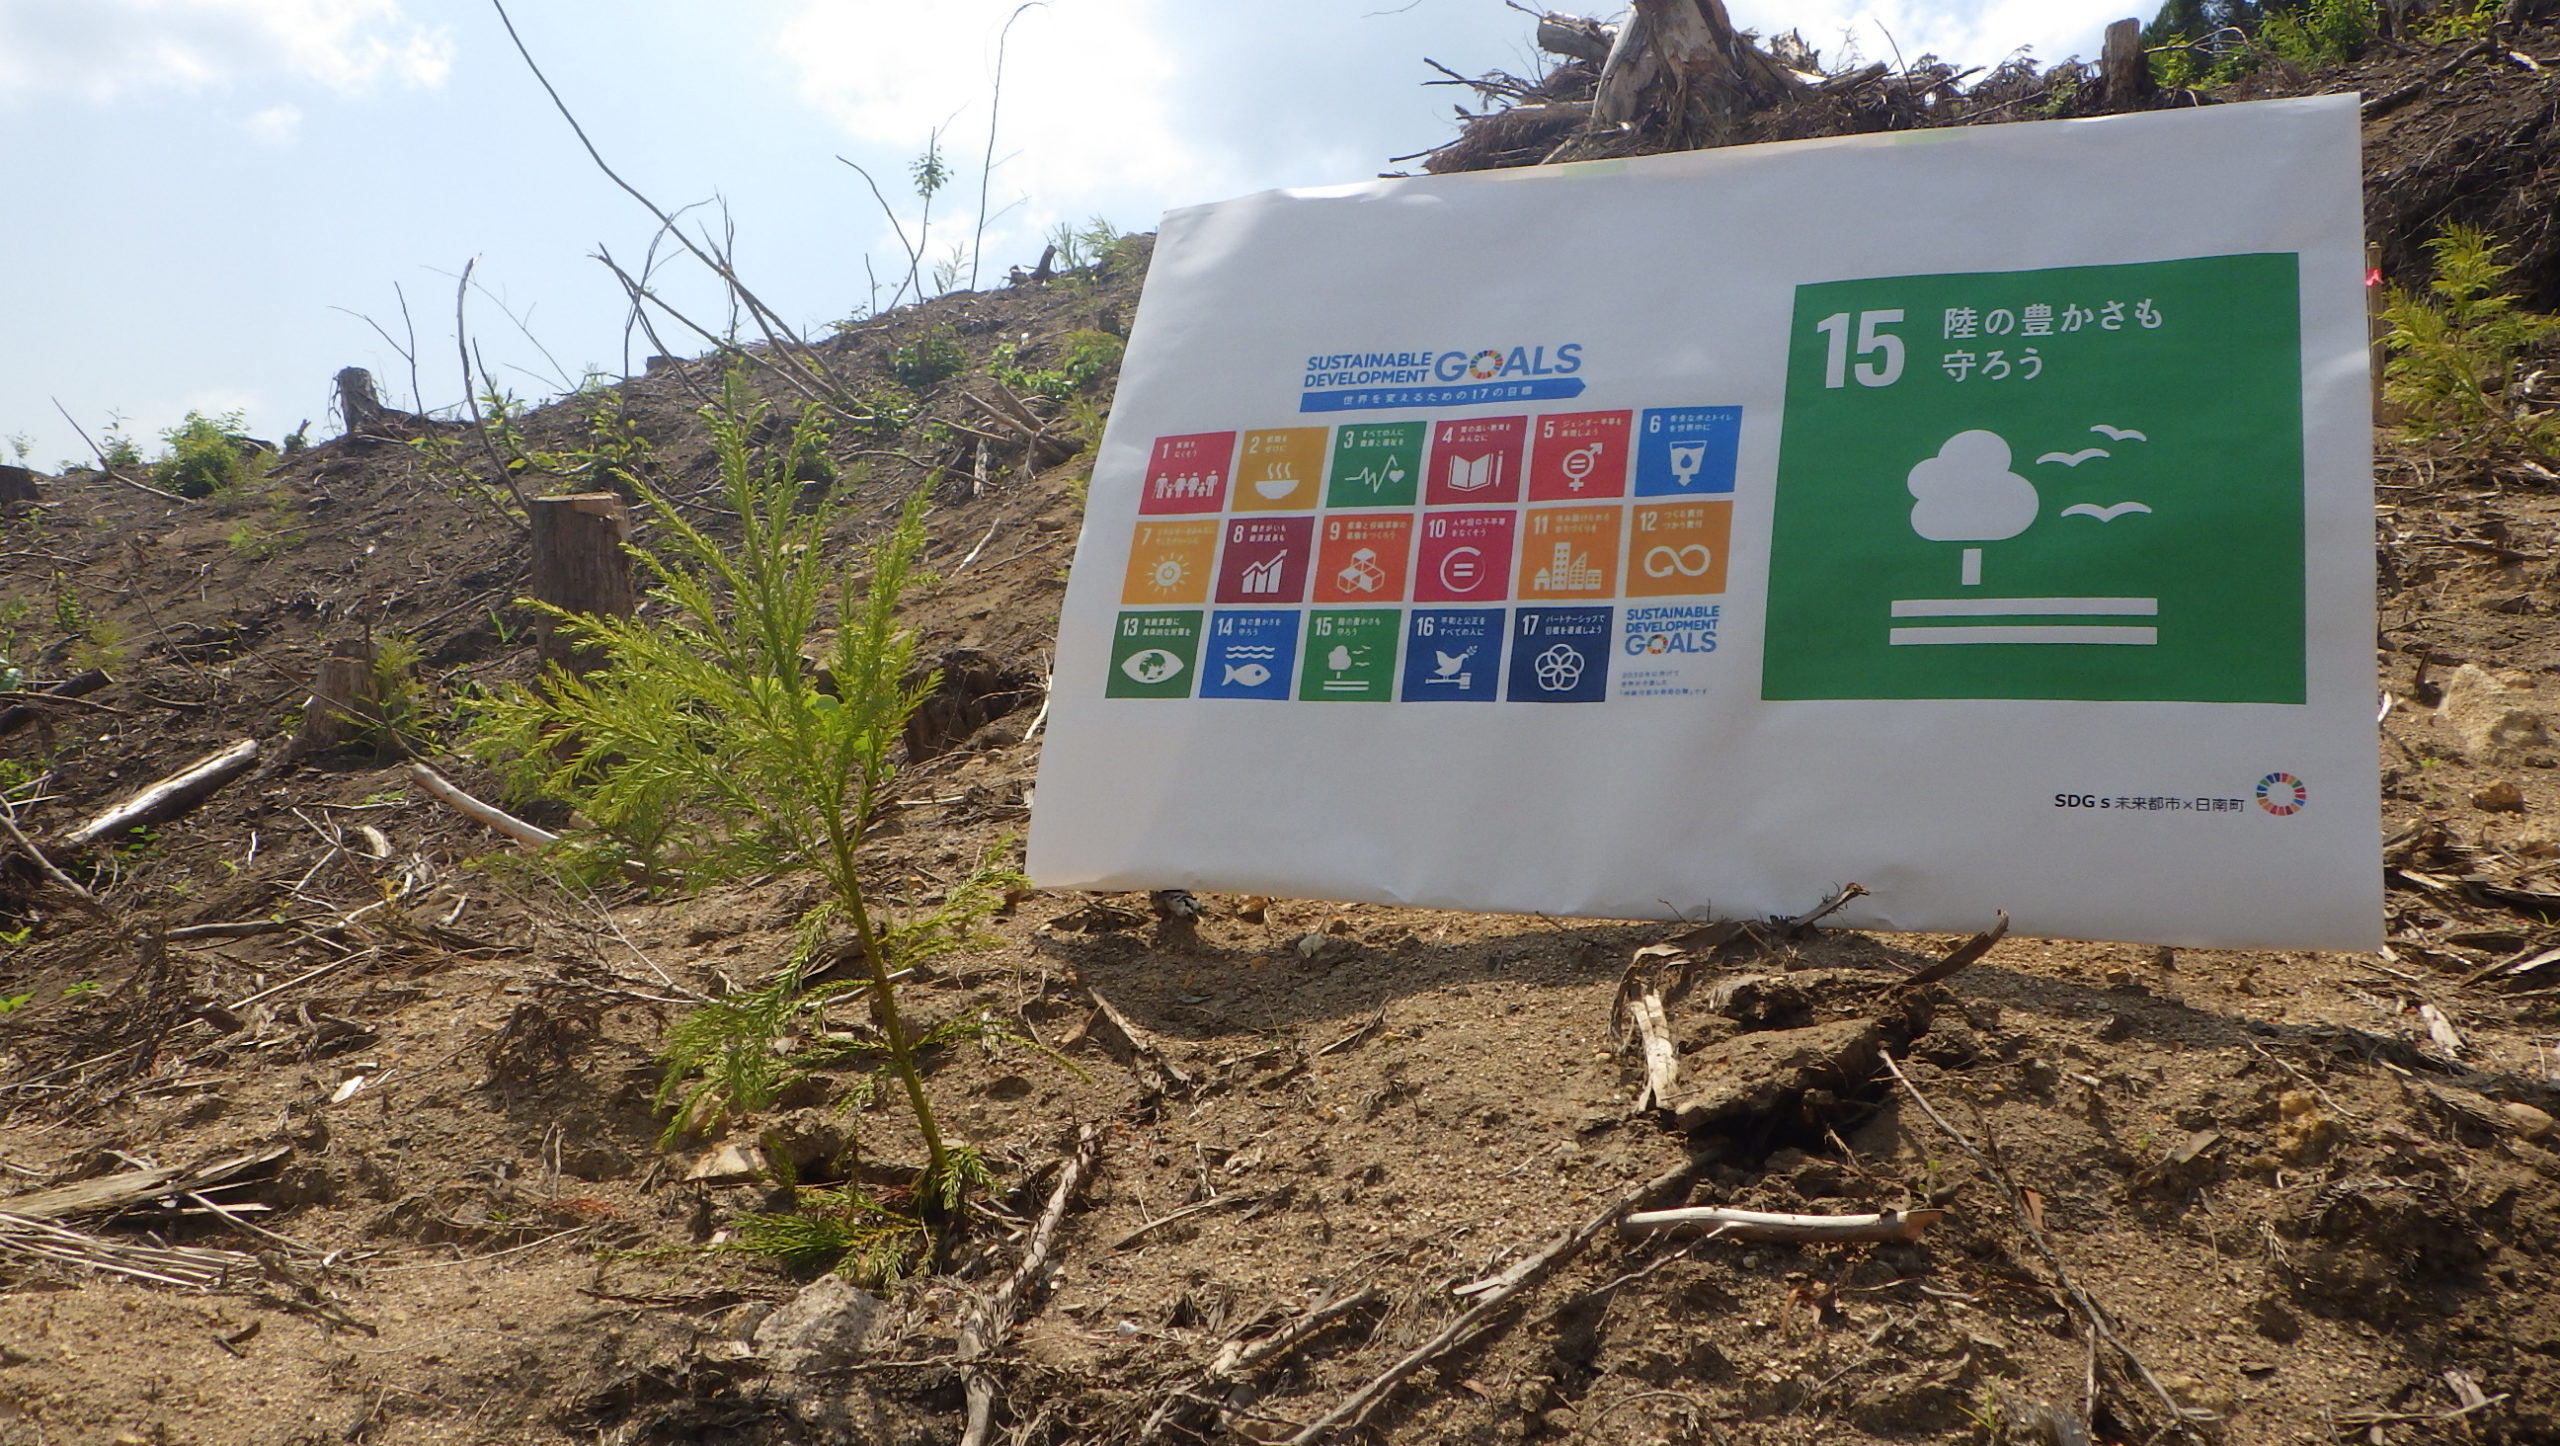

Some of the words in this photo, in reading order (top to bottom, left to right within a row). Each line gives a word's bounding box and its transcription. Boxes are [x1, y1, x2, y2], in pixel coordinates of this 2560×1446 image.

[1944, 298, 2163, 340] 陸の豊かさも
[1817, 308, 1906, 389] 15
[1307, 352, 1432, 371] SUSTAINABLE
[1434, 343, 1583, 382] GOALS
[1942, 346, 2043, 382] 守ろう
[1304, 369, 1429, 387] DEVELOPMENT
[1543, 421, 1554, 438] 5
[1649, 415, 1661, 433] 6
[1343, 430, 1354, 448] 3
[1442, 427, 1454, 443] 4
[1162, 443, 1170, 459] 1
[1250, 436, 1260, 454] 2
[1429, 519, 1446, 538] 10
[1534, 515, 1548, 535] 11
[1640, 511, 1658, 531] 12
[1142, 528, 1152, 545] 7
[1233, 525, 1244, 543] 8
[1329, 522, 1340, 541] 9
[1627, 606, 1720, 620] SUSTAINABLE
[1123, 618, 1139, 636] 13
[1217, 618, 1233, 636] 14
[1315, 617, 1332, 636] 15
[1417, 617, 1434, 636] 16
[1522, 614, 1539, 635] 17
[1626, 619, 1719, 633] DEVELOPMENT
[1625, 631, 1718, 655] GOALS
